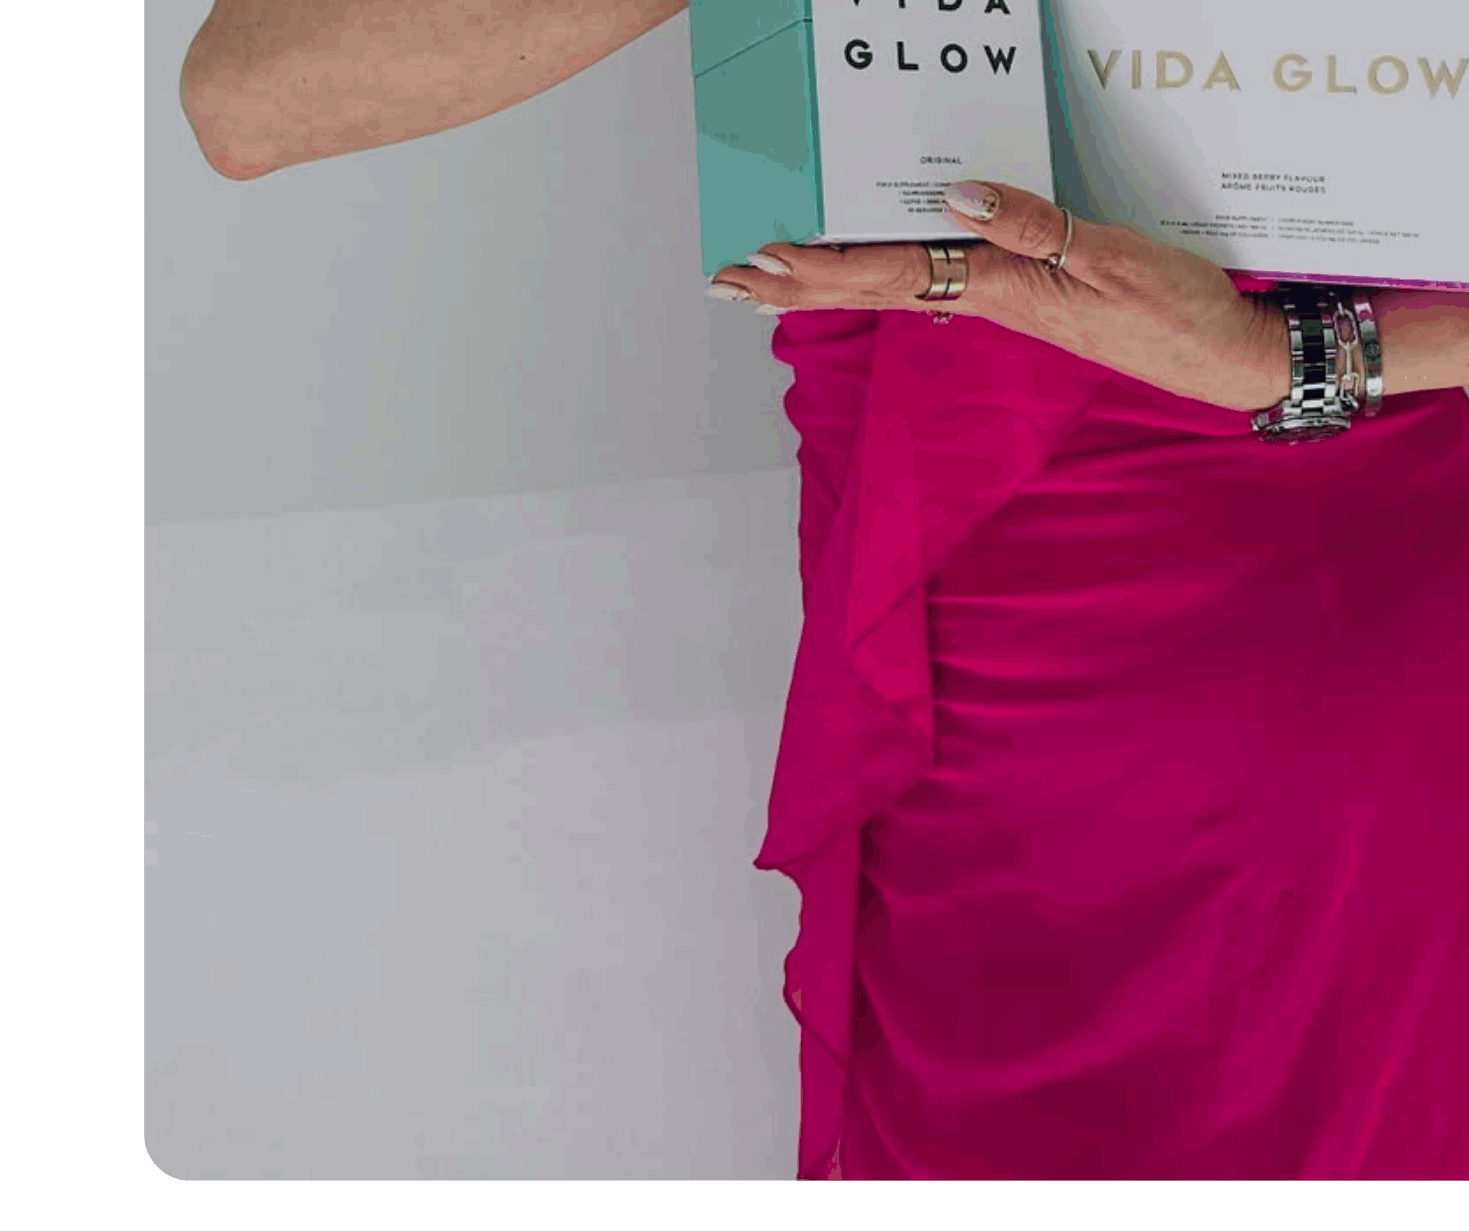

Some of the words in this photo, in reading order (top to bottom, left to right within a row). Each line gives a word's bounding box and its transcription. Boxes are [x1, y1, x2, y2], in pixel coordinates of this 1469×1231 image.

[844, 39, 1017, 75] GLOW
[1087, 49, 1242, 93] VIDA
[1271, 52, 1469, 100] GLOW
[920, 156, 962, 164] ORIGINAL
[1222, 172, 1249, 180] MIXED
[1253, 173, 1281, 181] BERRY
[1284, 175, 1326, 183] FLAVOUR
[1255, 184, 1286, 193] FRUITS
[1289, 185, 1326, 194] ROUGES
